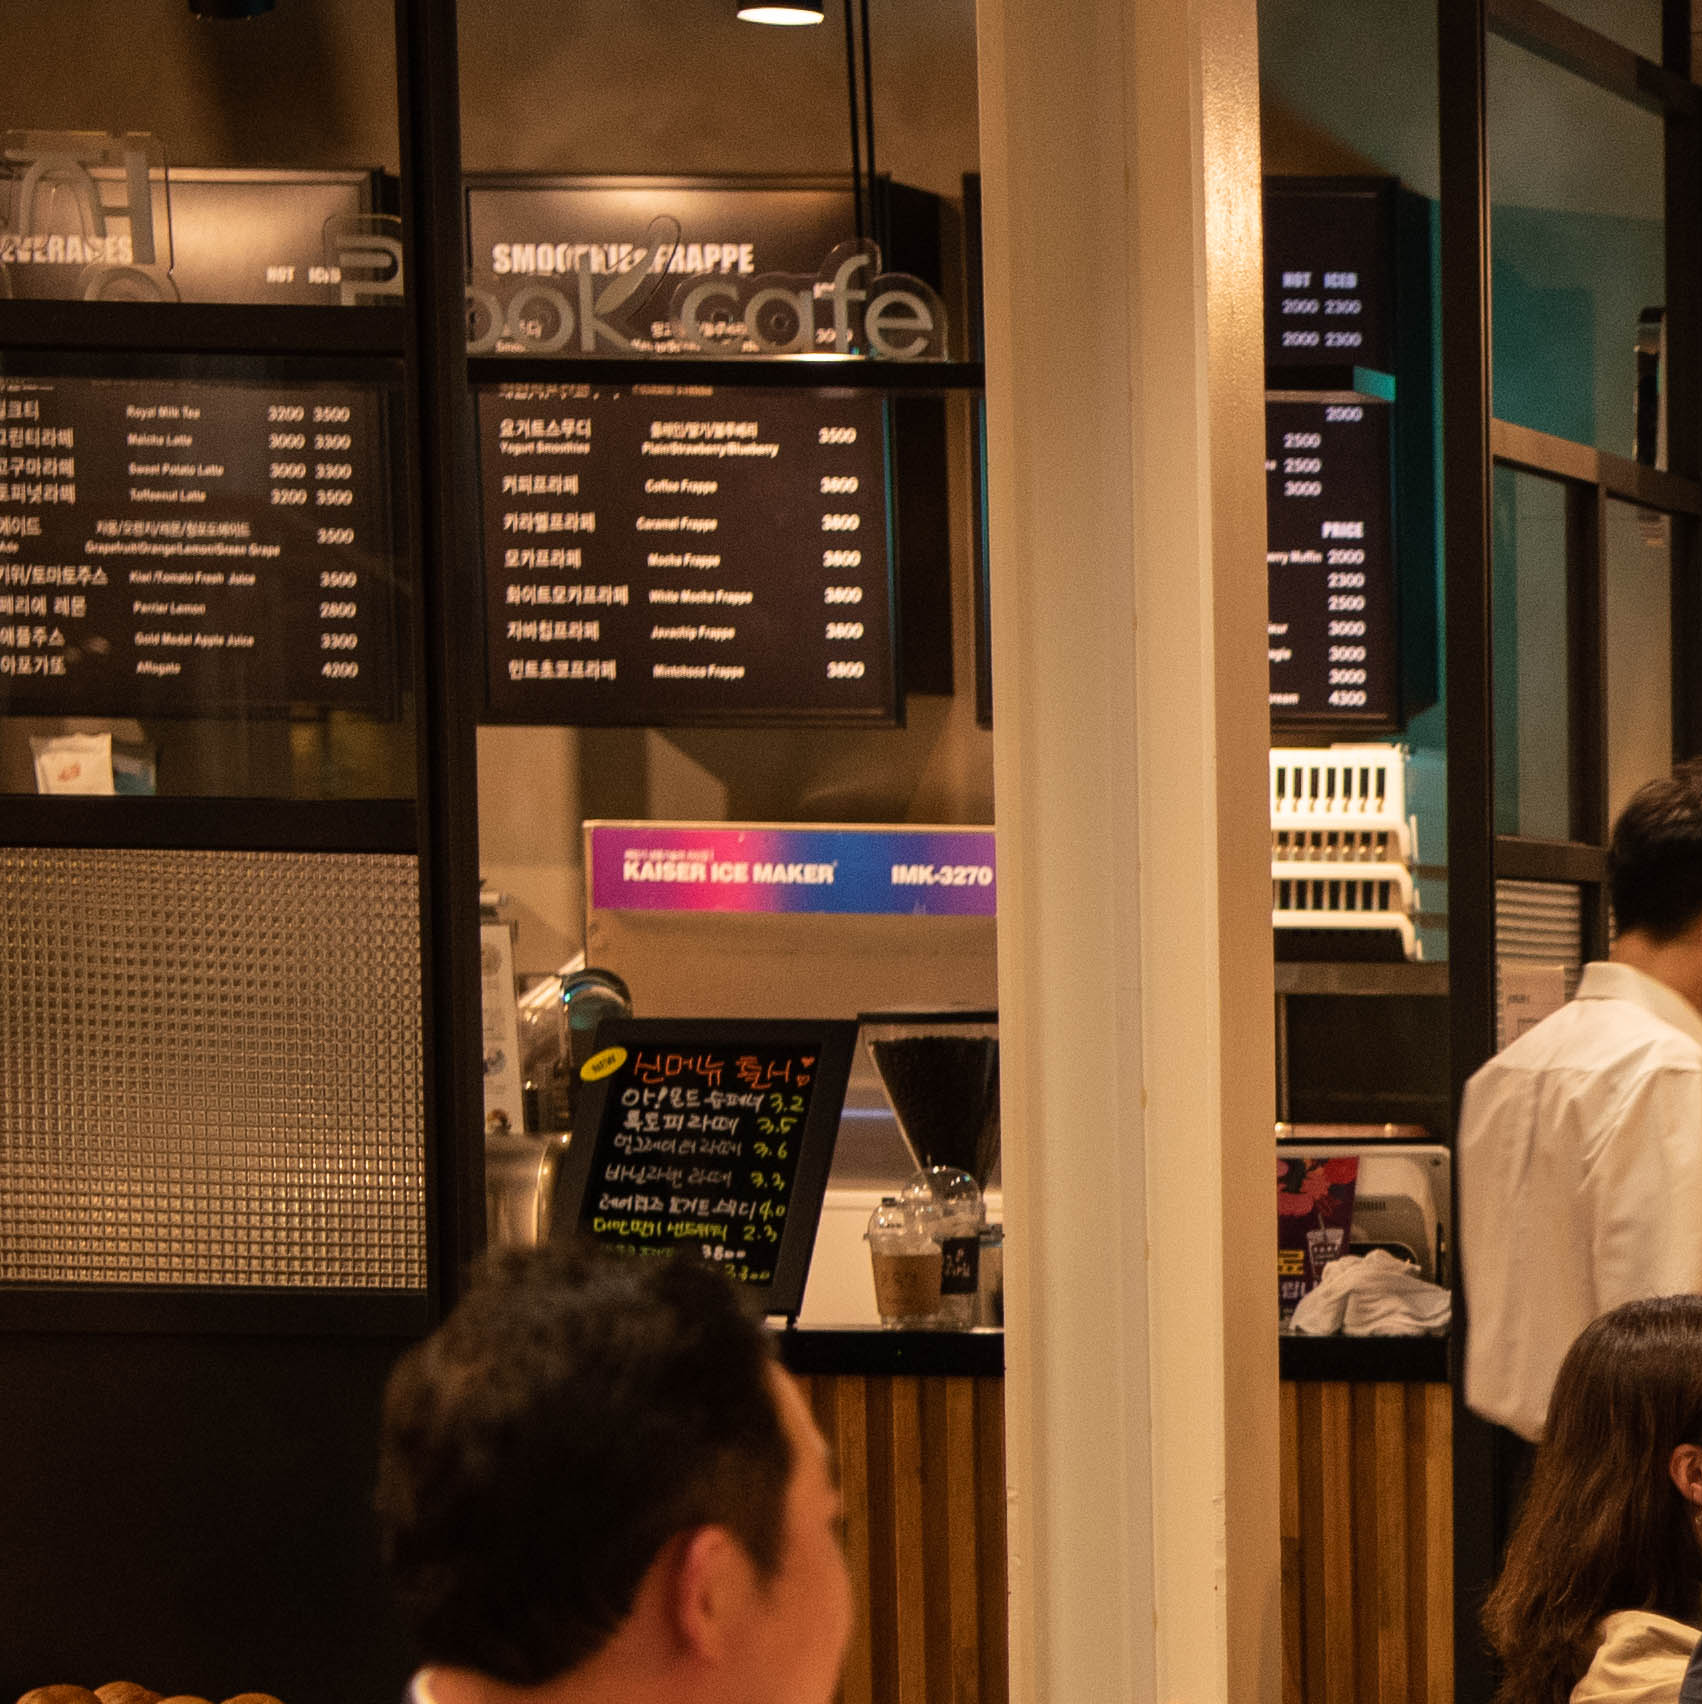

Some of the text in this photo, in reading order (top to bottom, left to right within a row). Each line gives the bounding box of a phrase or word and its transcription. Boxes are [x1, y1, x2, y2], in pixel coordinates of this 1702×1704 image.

[266, 266, 295, 282] HOT
[1283, 272, 1358, 289] HOT ICED
[680, 240, 934, 358] cafe
[1282, 299, 1361, 315] 2000 2300
[1282, 332, 1362, 348] 2000 2300
[158, 406, 179, 418] Milk
[268, 406, 349, 422] 3200 3500
[1326, 406, 1363, 423] 2000
[167, 433, 192, 447] Latte
[269, 433, 351, 450] 3000 3300
[819, 427, 857, 445] 3500
[1284, 433, 1321, 449] 2500
[162, 463, 194, 477] Potato
[197, 463, 224, 477] Latte
[270, 463, 352, 480] 3000 3300
[1284, 458, 1321, 474] 2500
[180, 489, 206, 503] Latte
[644, 479, 718, 496] Coffee Frappe
[1284, 480, 1322, 497] 3000
[271, 488, 353, 506] 3200 3500
[680, 516, 718, 534] Frappe
[1322, 522, 1364, 539] PRICE
[317, 528, 354, 545] 3500
[682, 553, 720, 570] Frappe
[1328, 549, 1364, 565] 2000
[228, 572, 256, 587] Juice
[320, 572, 357, 589] 3500
[1328, 573, 1365, 589] 2300
[649, 590, 678, 605] White
[715, 590, 753, 606] Frappe
[1328, 595, 1365, 611] 2500
[170, 602, 206, 616] Lemon
[698, 625, 735, 642] Frappe
[1328, 620, 1365, 637] 3000
[135, 632, 160, 647] Gold
[194, 632, 225, 650] Apple
[227, 633, 254, 648] Juice
[321, 633, 357, 650] 3300
[1329, 645, 1366, 662] 3000
[321, 661, 358, 679] 4200
[708, 664, 745, 681] Frappe
[1329, 668, 1366, 685] 3000
[1329, 690, 1366, 707] 4300
[623, 862, 992, 886] KAISER ICE MAKER IMK-3270
[634, 1052, 725, 1087] 신메뉴
[770, 1095, 804, 1113] 3.2
[757, 1117, 797, 1134] 3.5
[753, 1141, 788, 1160] 3.6
